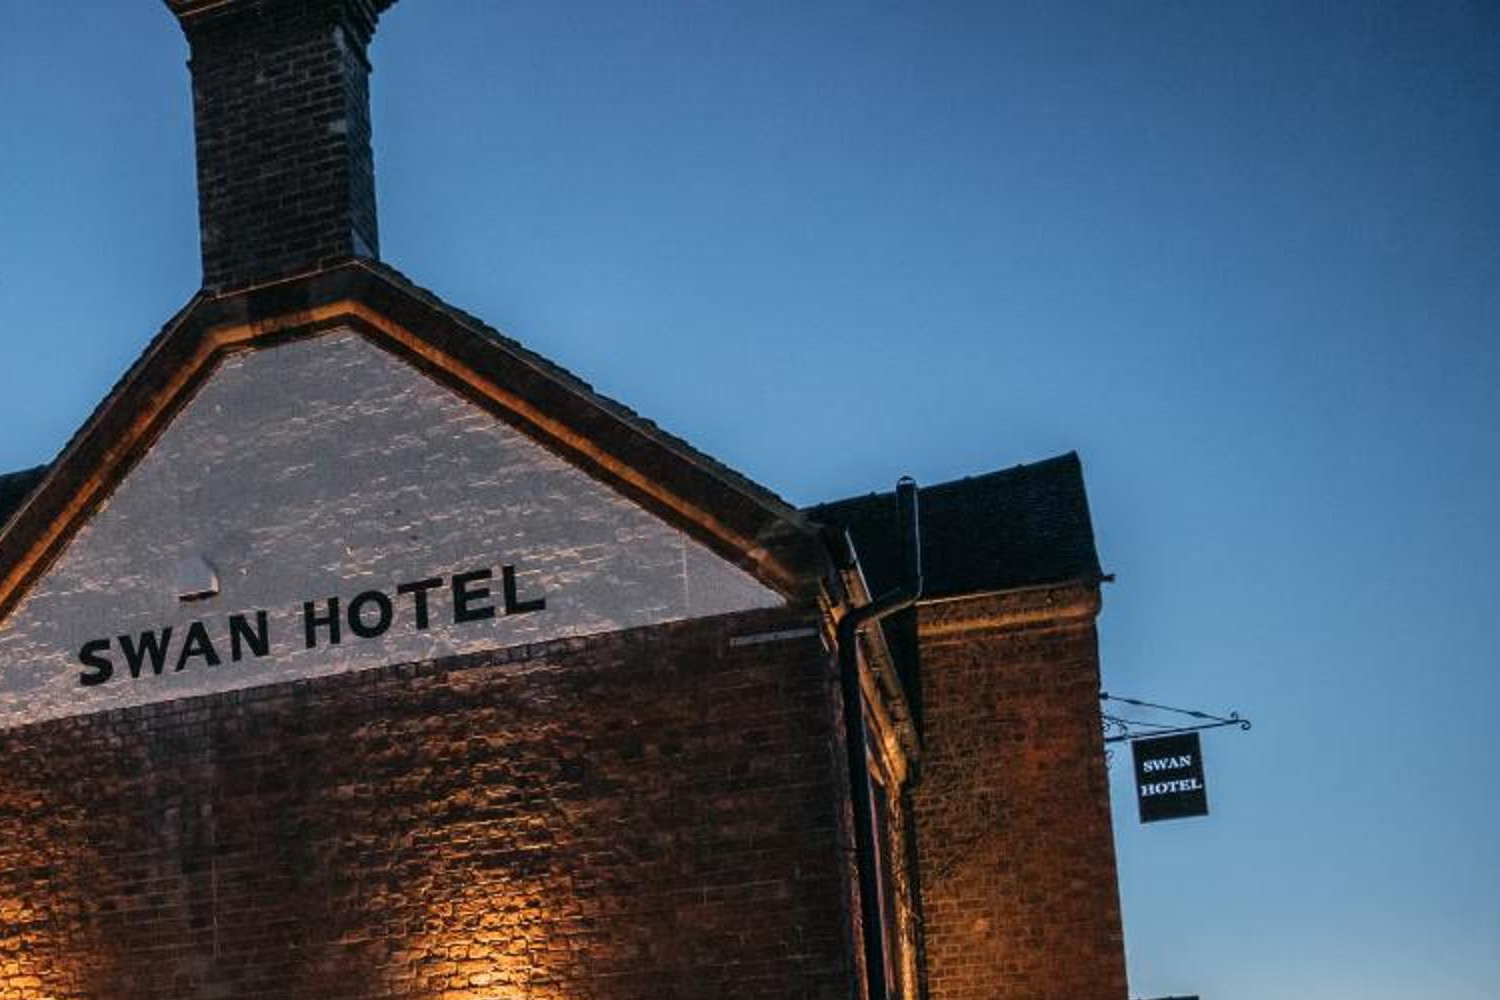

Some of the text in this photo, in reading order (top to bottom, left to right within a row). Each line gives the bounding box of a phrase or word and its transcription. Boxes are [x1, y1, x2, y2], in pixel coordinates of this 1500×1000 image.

[78, 565, 547, 687] SWAN HOTEL
[1143, 755, 1192, 773] SWAN
[1141, 778, 1203, 797] HOTEL
